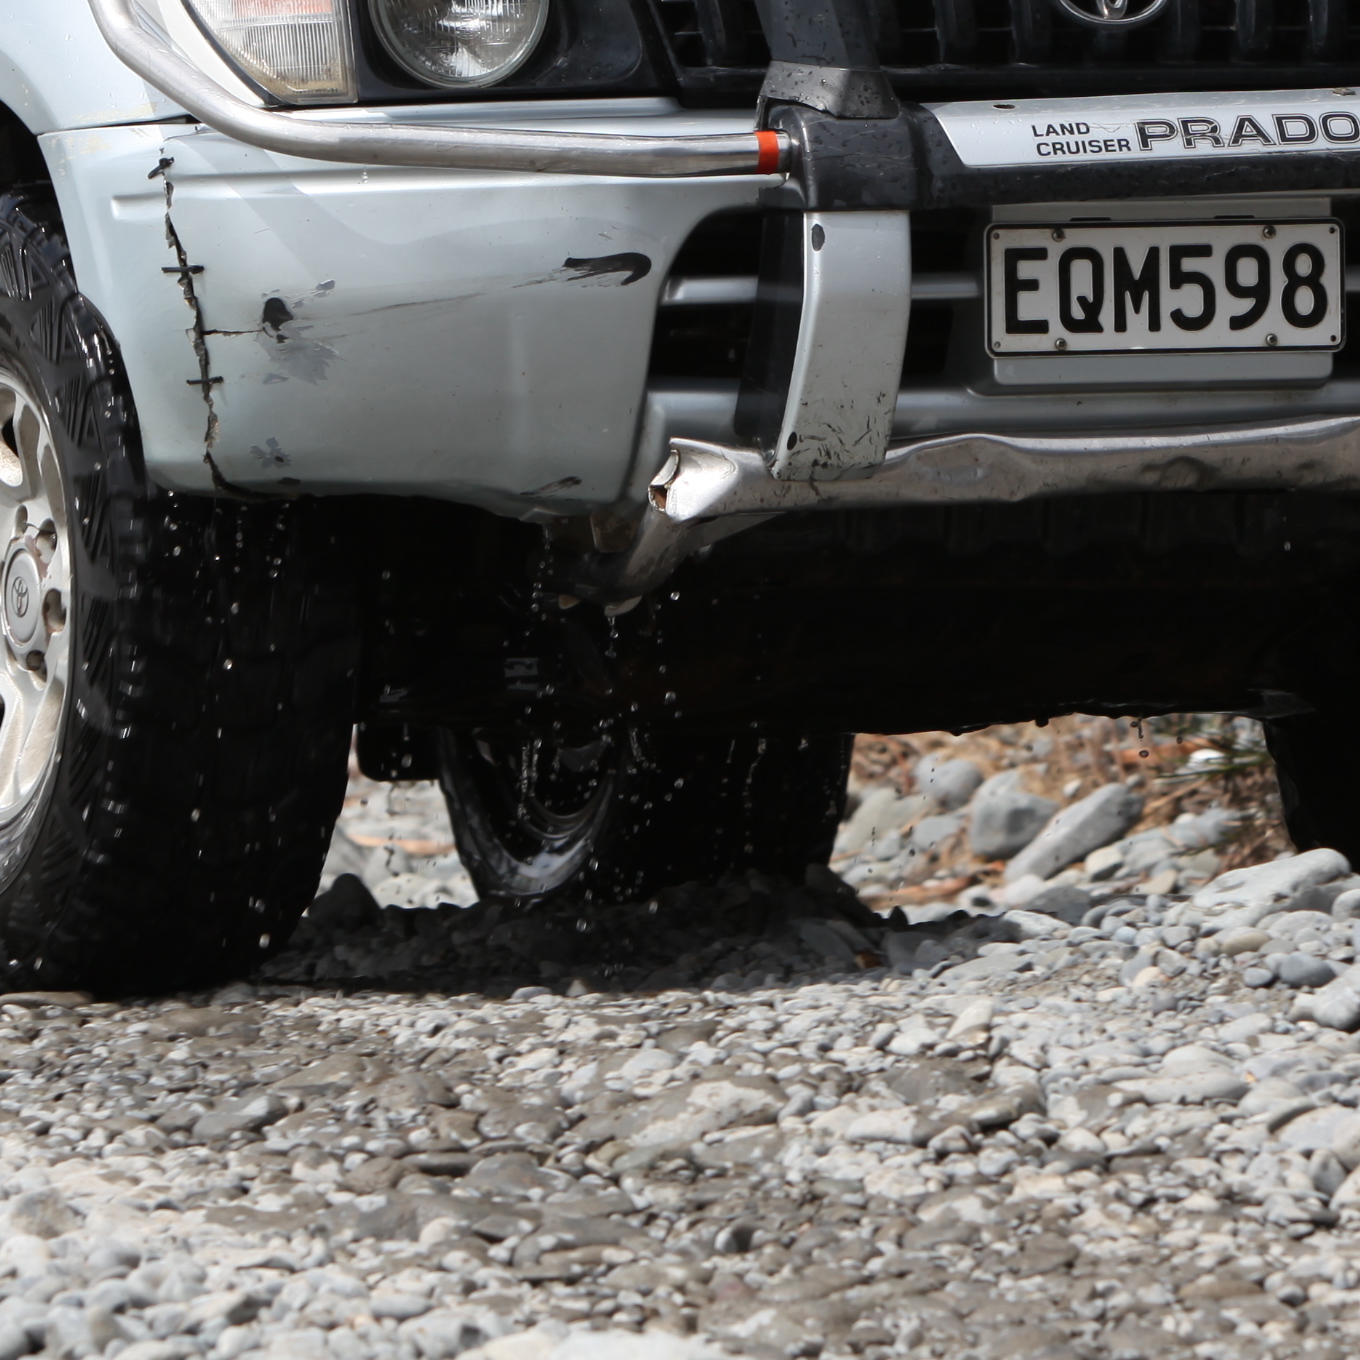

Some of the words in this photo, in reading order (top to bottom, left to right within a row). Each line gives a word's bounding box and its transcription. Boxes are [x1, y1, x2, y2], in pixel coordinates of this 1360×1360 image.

[1031, 121, 1091, 139] LAND
[1036, 136, 1132, 158] CRUISER
[1004, 242, 1329, 335] EQM598
